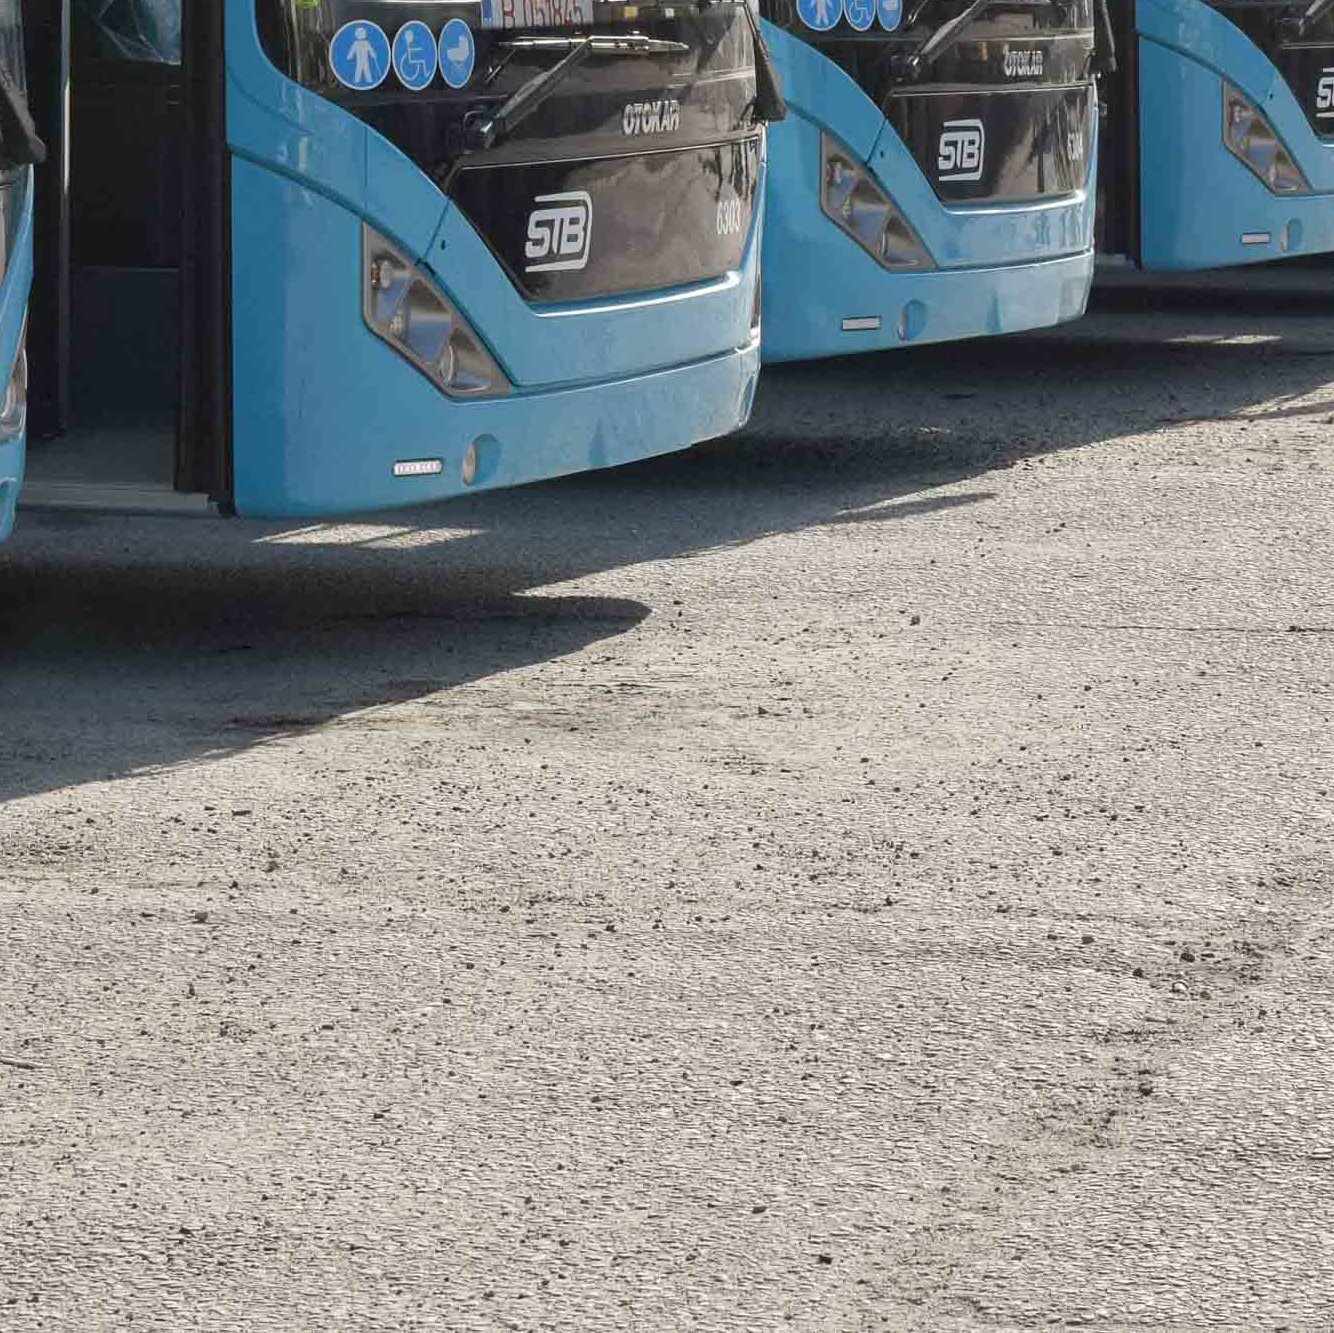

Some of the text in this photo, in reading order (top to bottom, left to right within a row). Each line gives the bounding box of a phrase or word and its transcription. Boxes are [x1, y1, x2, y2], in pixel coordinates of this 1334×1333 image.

[622, 99, 681, 136] OTOKAR
[938, 130, 981, 171] STB
[525, 205, 587, 260] STB
